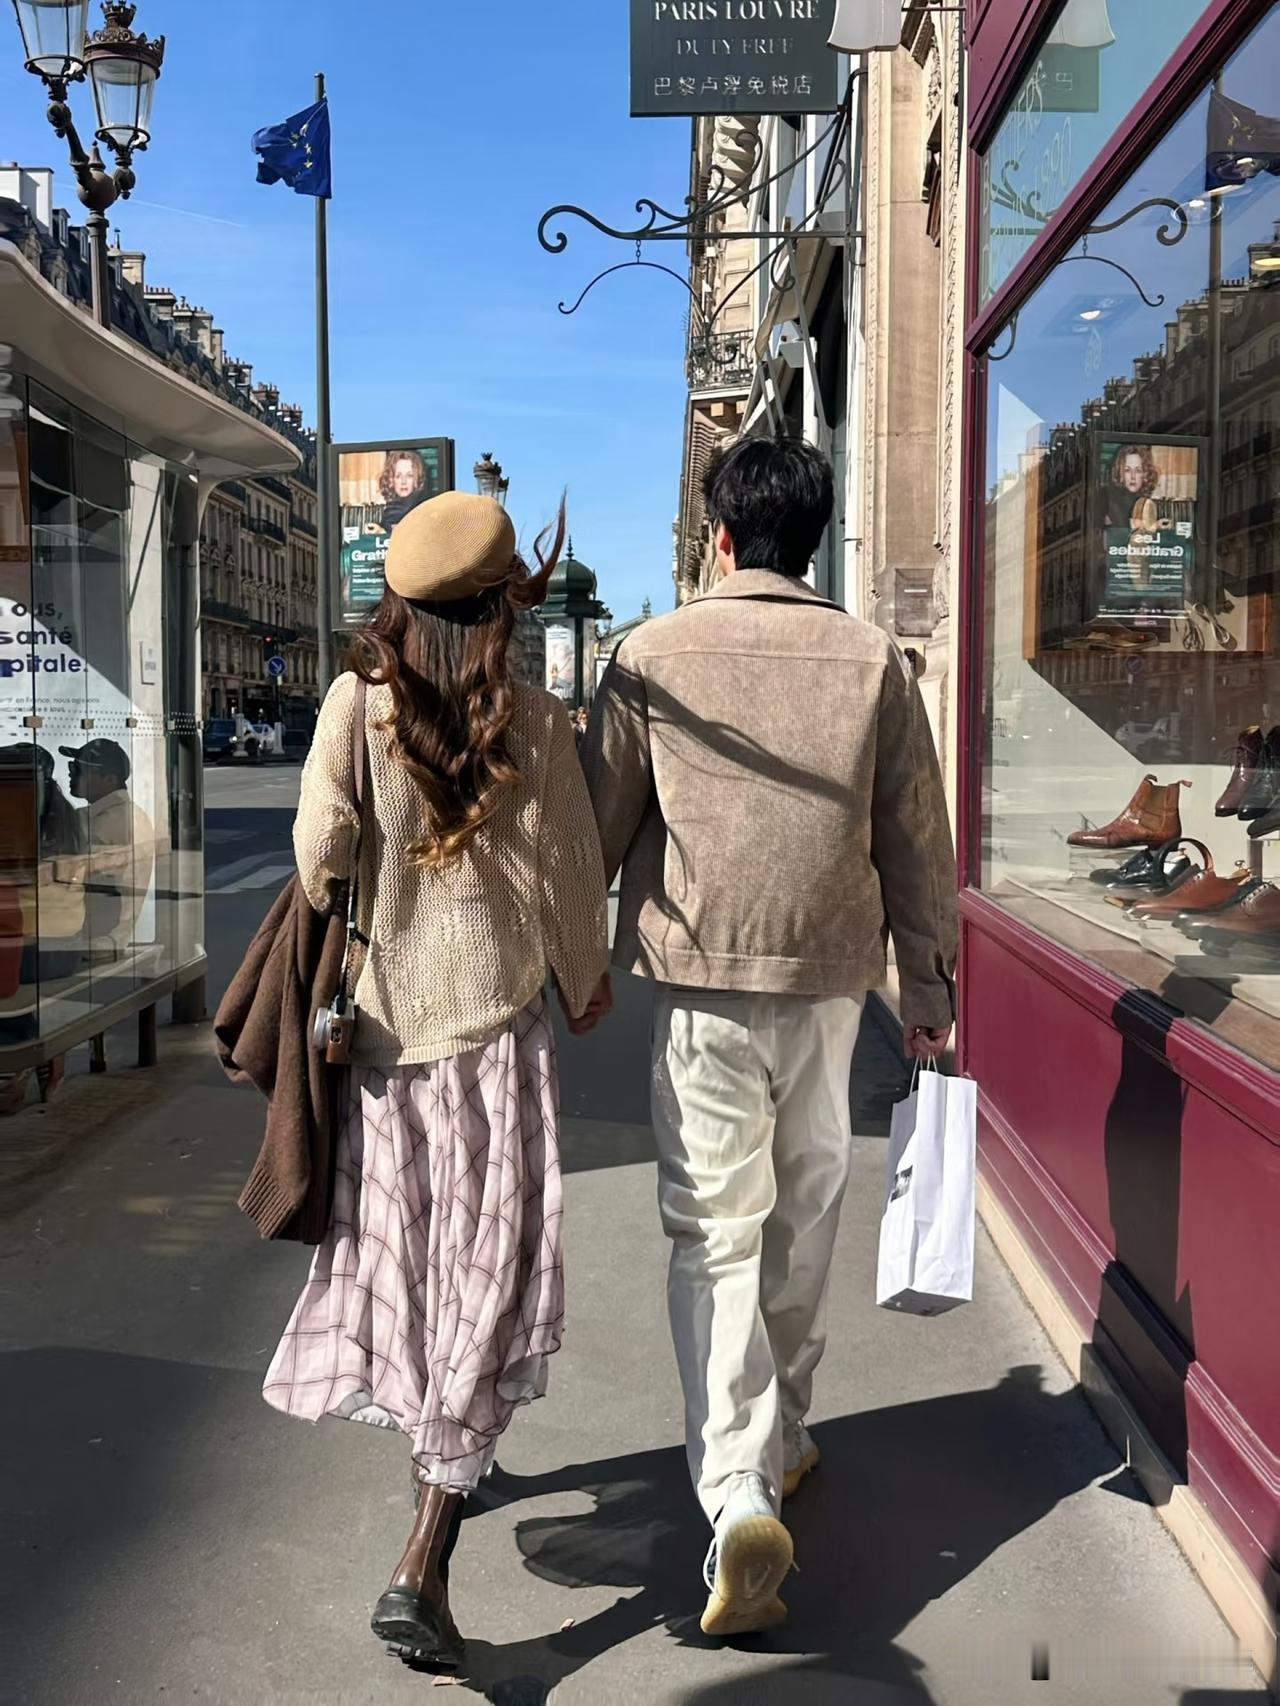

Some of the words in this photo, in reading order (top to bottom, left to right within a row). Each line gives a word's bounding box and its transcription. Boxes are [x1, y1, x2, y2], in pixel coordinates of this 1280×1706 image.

[654, 1, 718, 21] PARIS
[725, 0, 819, 20] LOUVRE
[676, 38, 734, 55] DUTY
[742, 37, 793, 55] FREE
